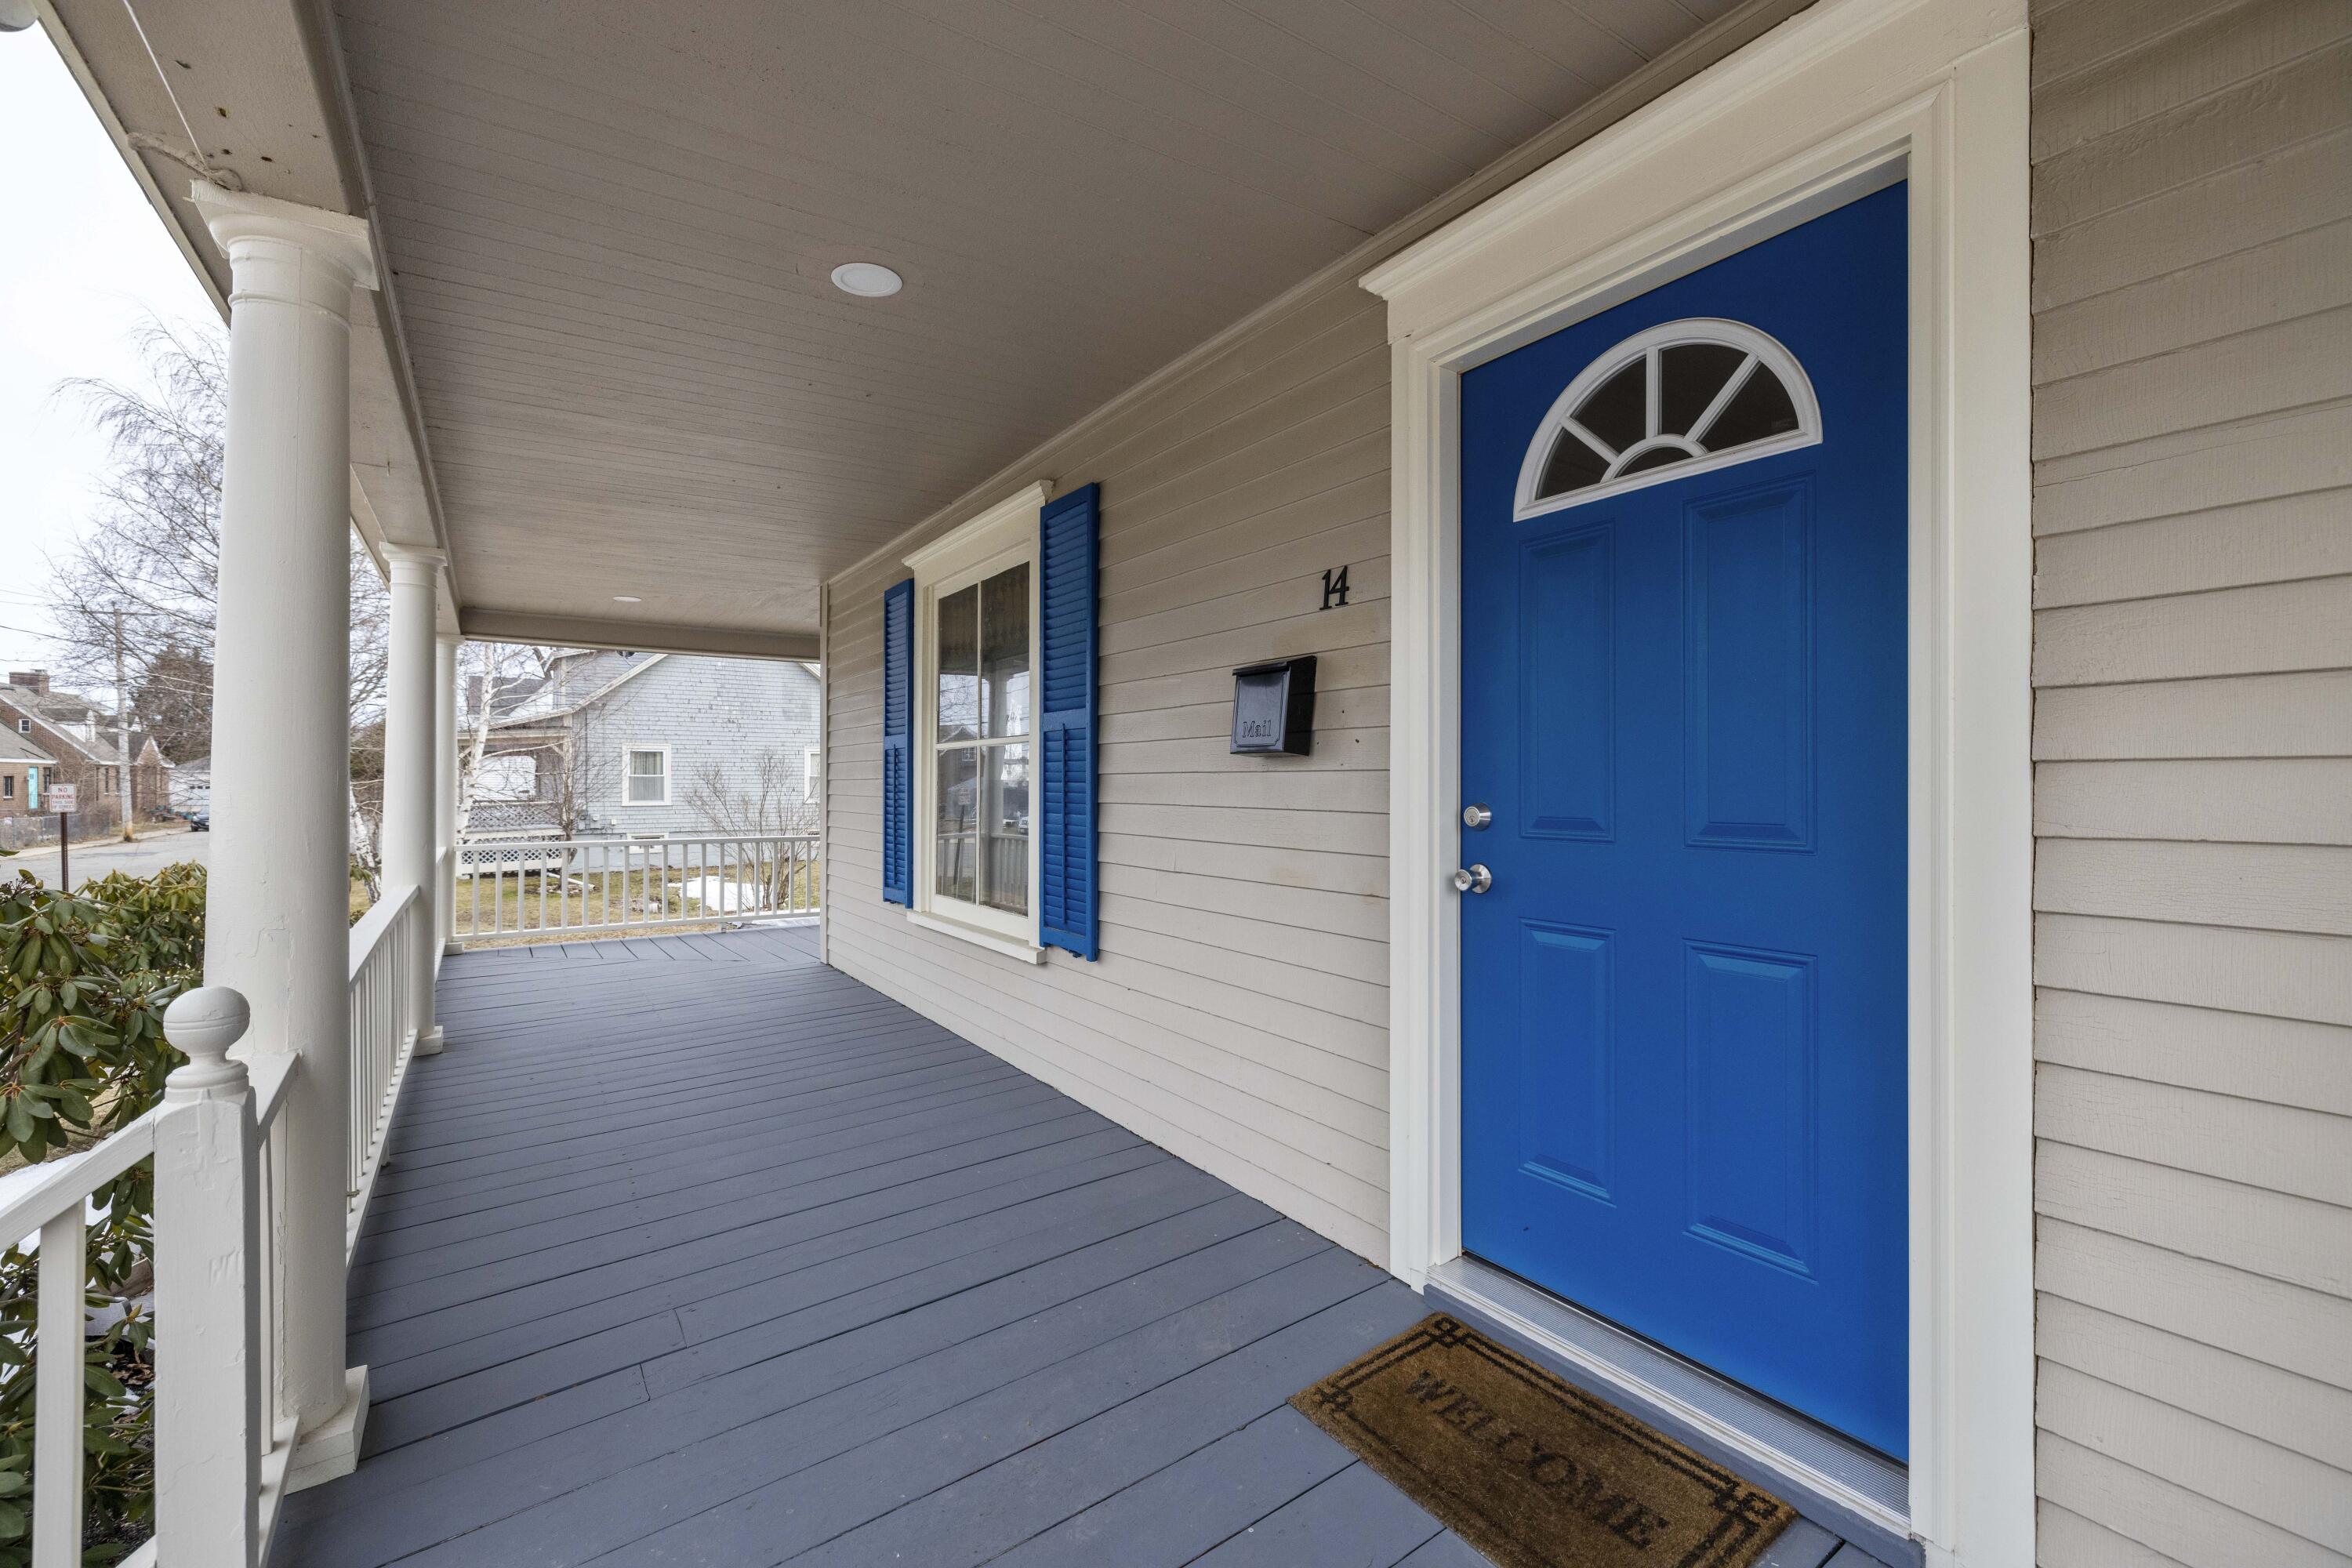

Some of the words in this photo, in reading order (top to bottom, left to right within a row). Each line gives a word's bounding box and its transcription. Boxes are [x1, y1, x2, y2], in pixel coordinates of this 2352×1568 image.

[1319, 565, 1349, 610] 14
[1242, 720, 1272, 738] Mail
[1406, 1369, 1669, 1551] WELCOME
